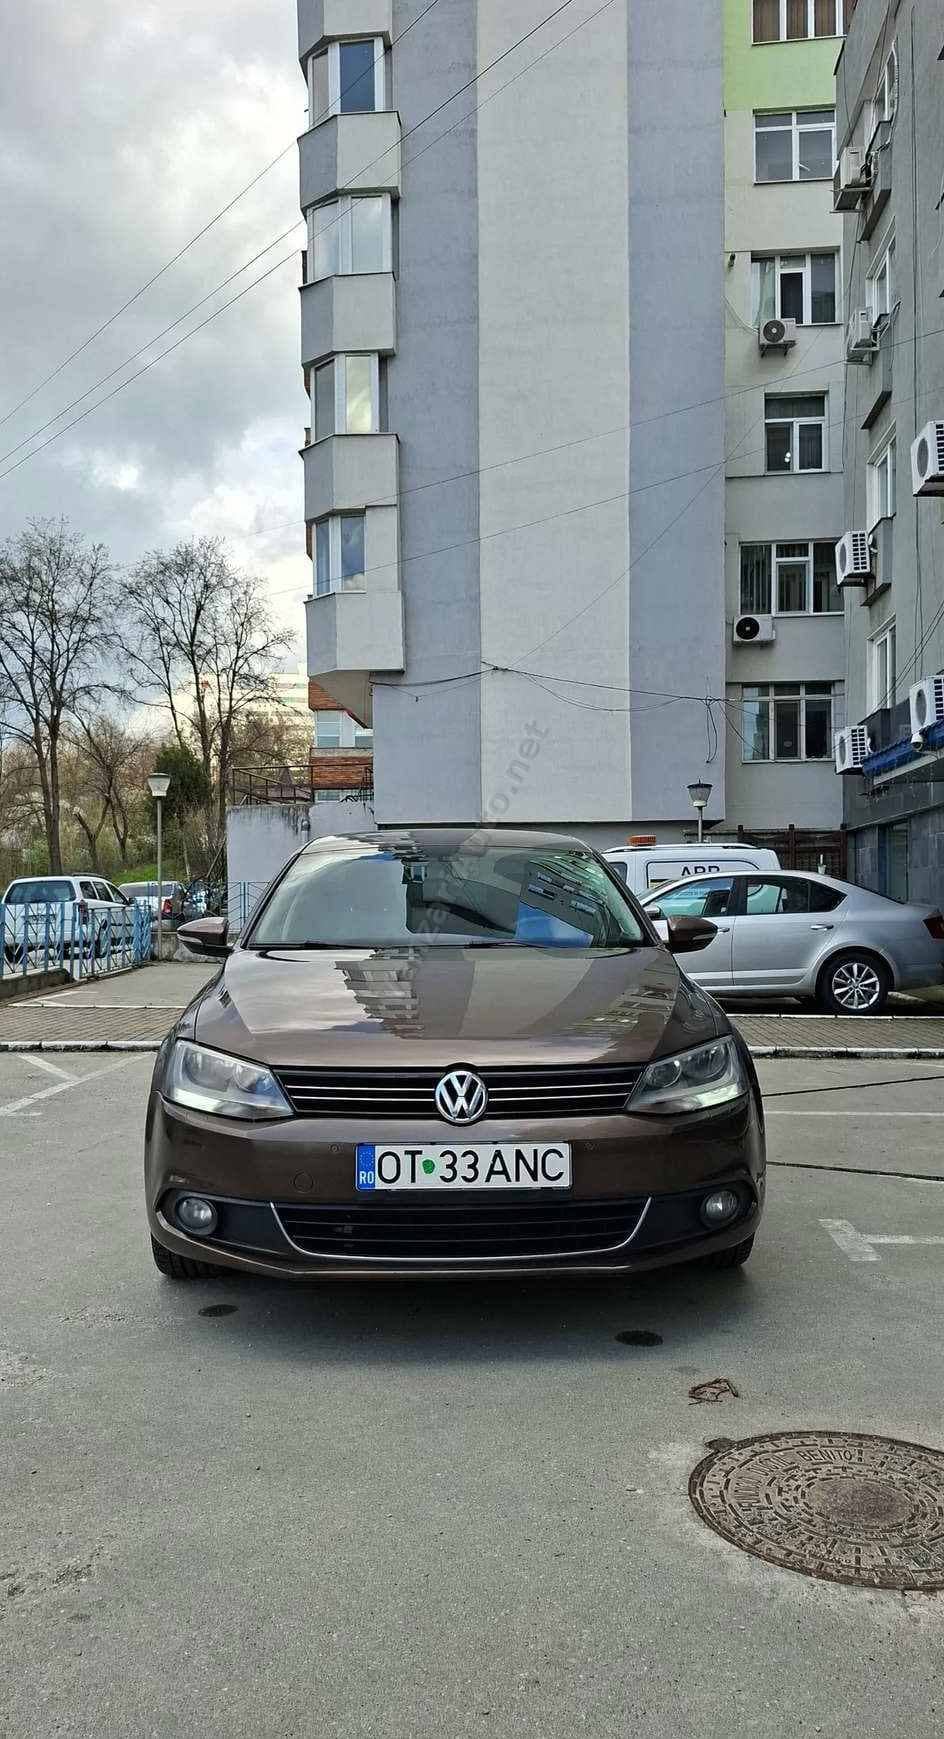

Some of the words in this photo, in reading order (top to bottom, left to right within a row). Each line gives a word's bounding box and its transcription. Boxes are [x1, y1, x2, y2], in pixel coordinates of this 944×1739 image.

[377, 1150, 423, 1184] OT
[439, 1150, 479, 1183] 33
[485, 1149, 564, 1183] ANC
[359, 1171, 375, 1184] RO
[796, 1449, 853, 1461] BENITO
